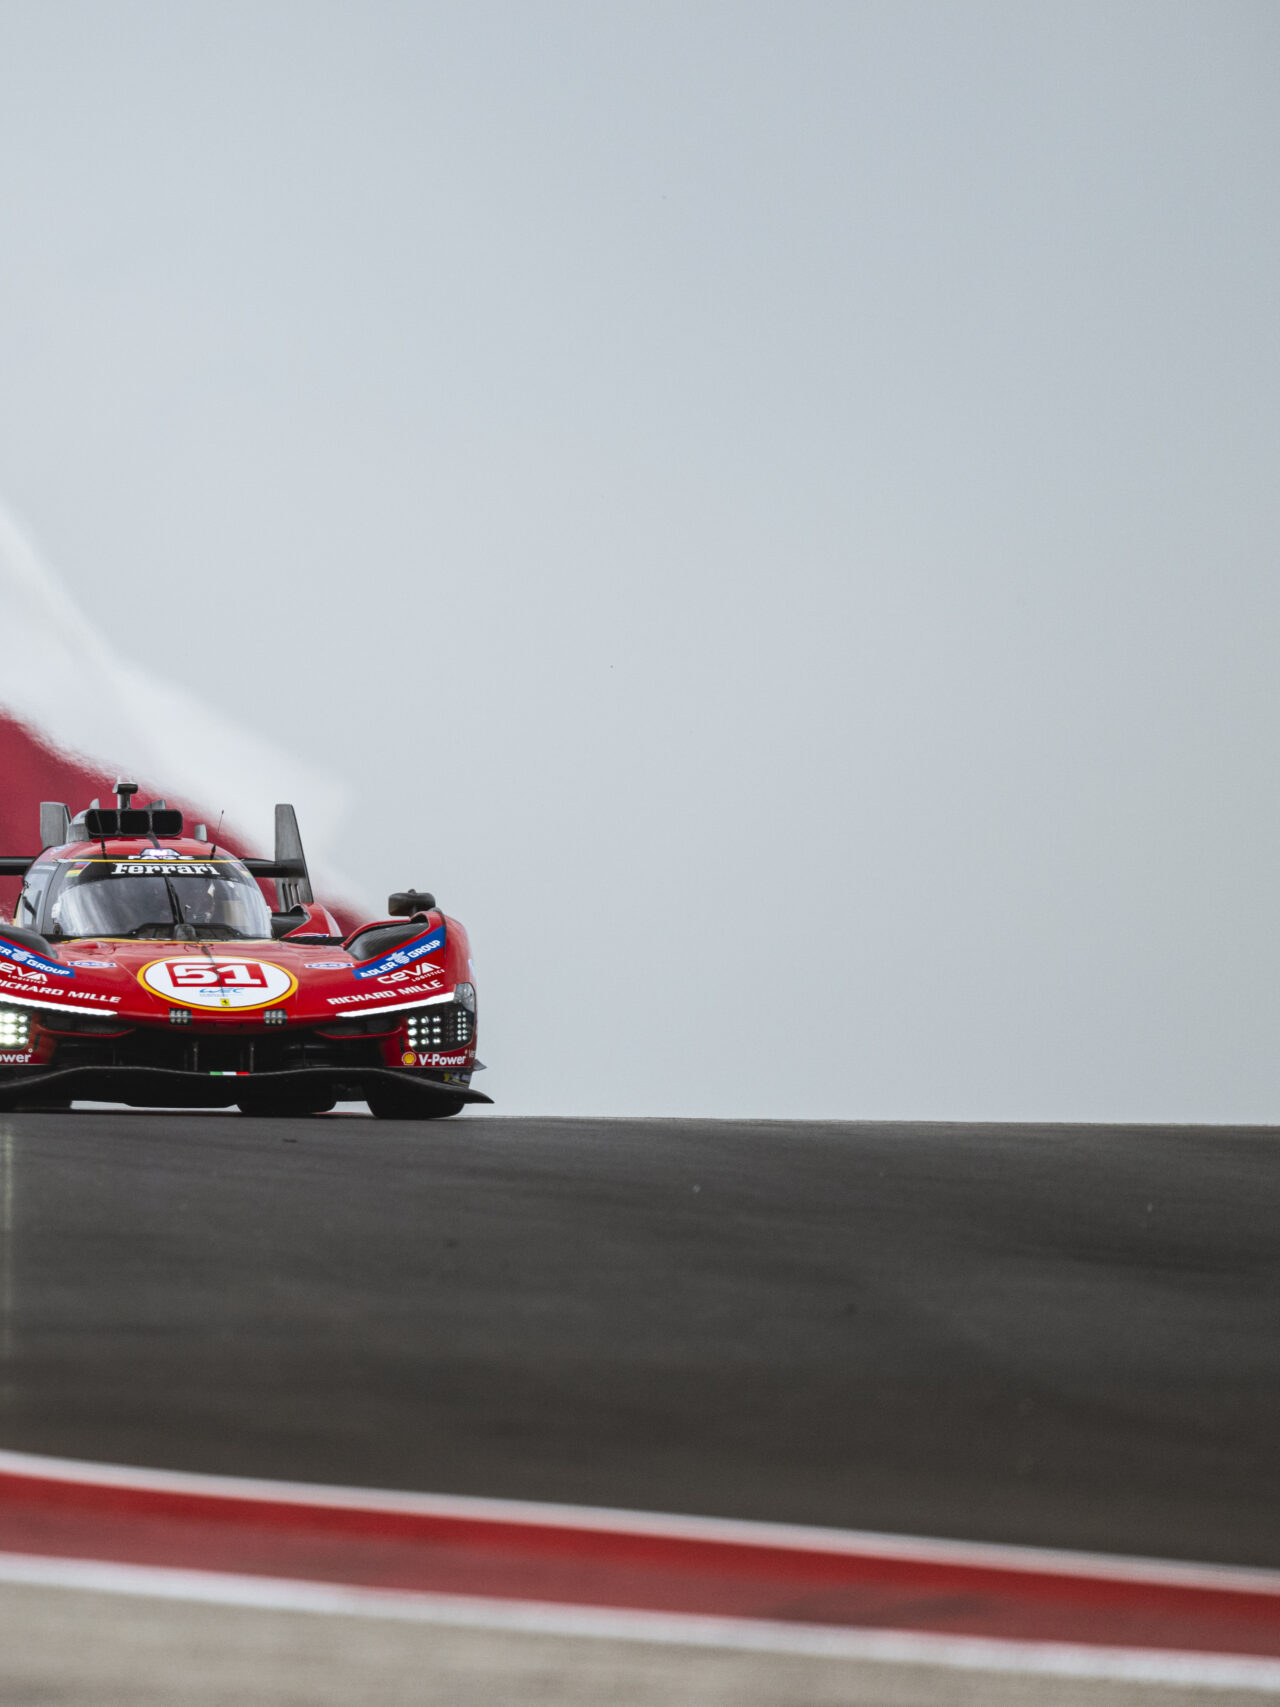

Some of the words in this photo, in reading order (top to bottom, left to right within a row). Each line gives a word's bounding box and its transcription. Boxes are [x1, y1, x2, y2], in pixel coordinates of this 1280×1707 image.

[111, 862, 220, 875] Ferrari
[360, 961, 398, 978] ADLER
[408, 940, 440, 958] GROUP
[26, 959, 71, 976] GROUP
[172, 964, 262, 985] 51
[7, 974, 47, 985] LOGISTICS
[411, 968, 446, 983] LOGISTICS
[67, 990, 122, 1004] MILLE
[327, 990, 396, 1005] RICHARD
[398, 979, 443, 995] MILLE
[418, 1053, 467, 1066] V-Power
